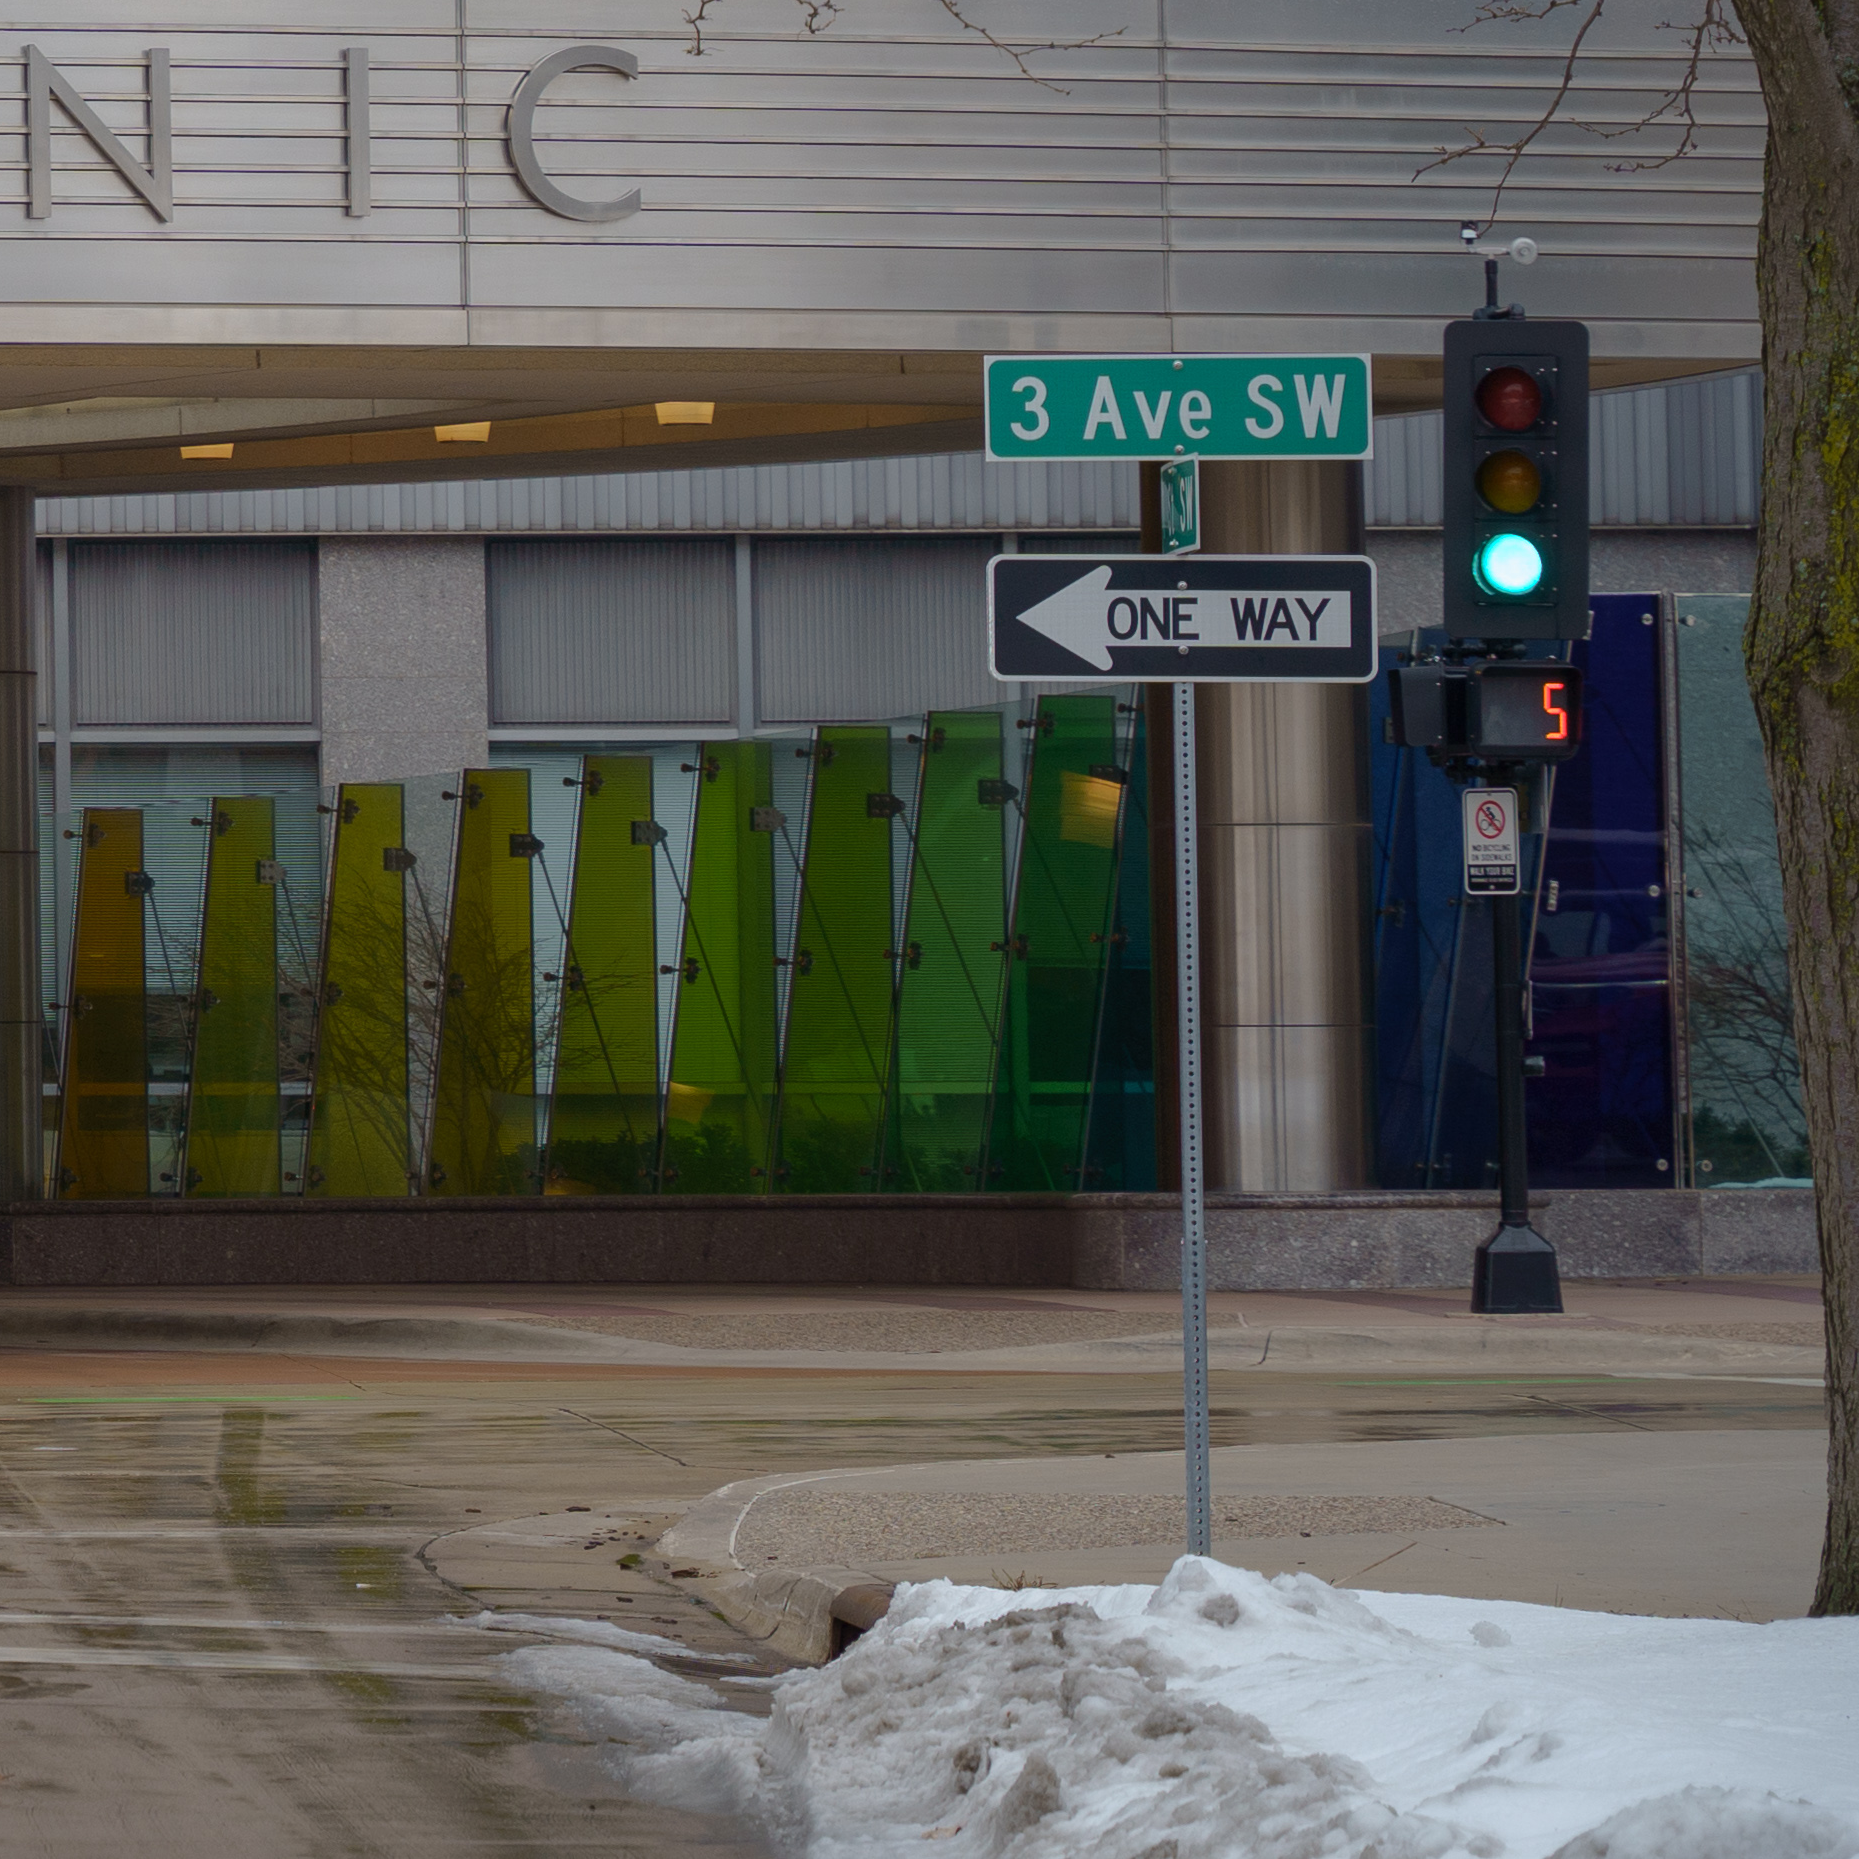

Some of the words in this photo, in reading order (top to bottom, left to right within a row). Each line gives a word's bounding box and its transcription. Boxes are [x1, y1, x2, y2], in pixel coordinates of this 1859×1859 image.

[1010, 376, 1050, 441] 3
[1083, 375, 1212, 440] Ave
[1245, 374, 1346, 439] SW
[1107, 597, 1200, 641] ONE
[1230, 597, 1331, 641] WAY
[1543, 682, 1568, 740] 5
